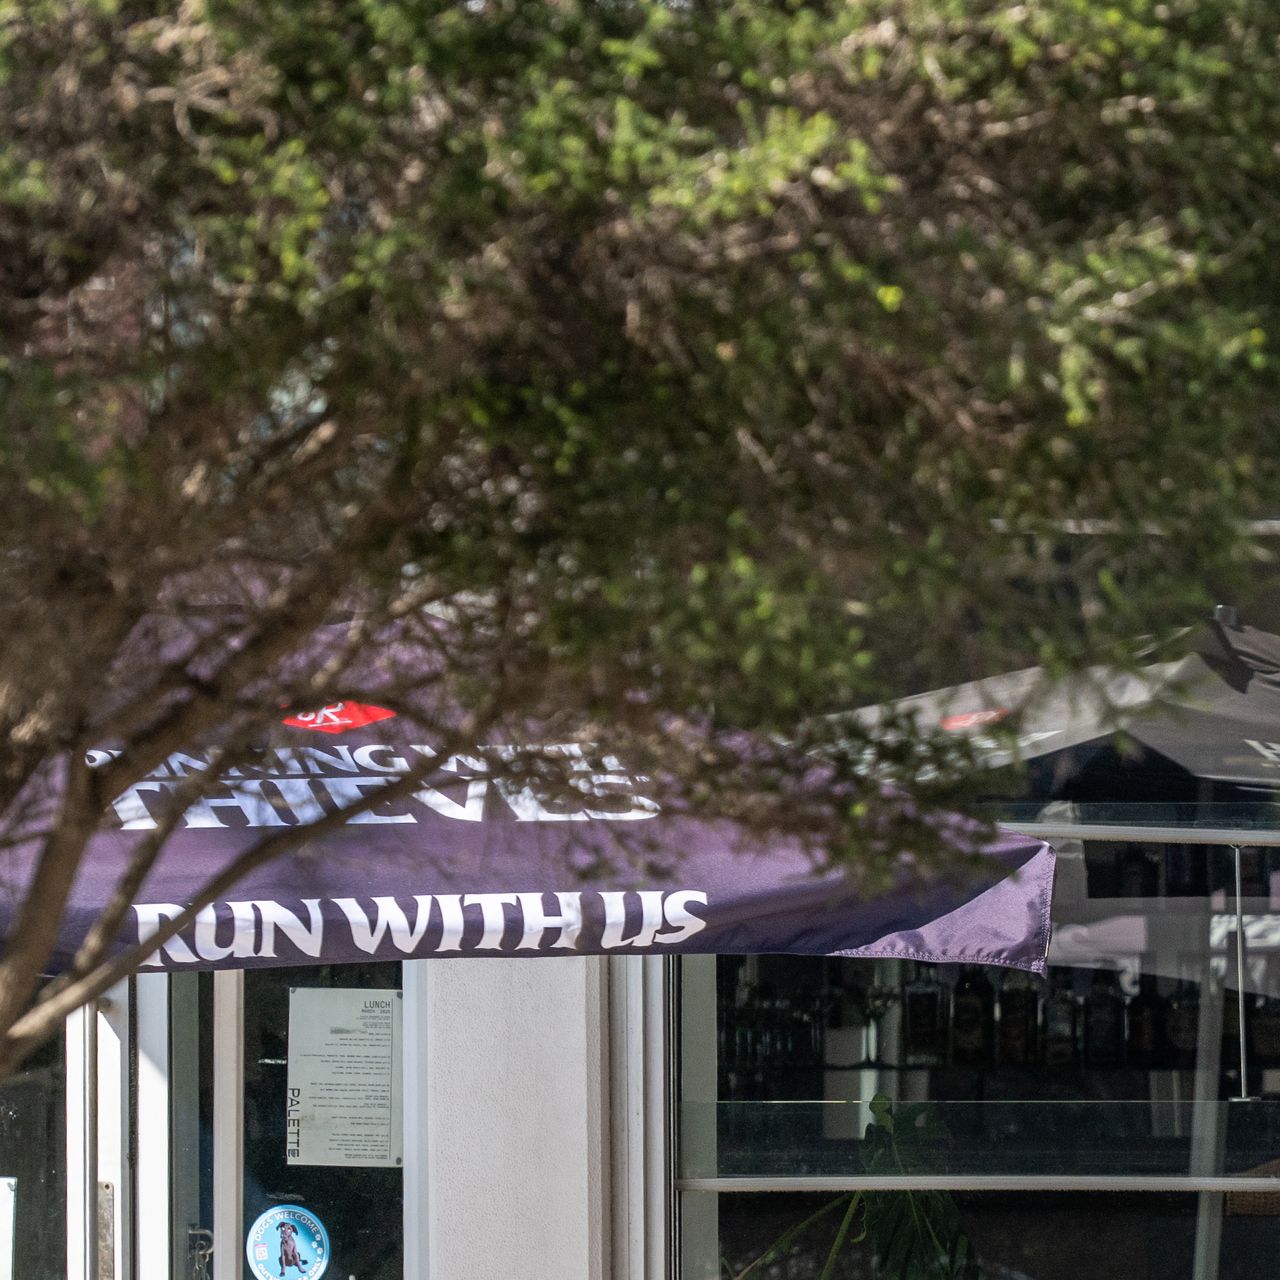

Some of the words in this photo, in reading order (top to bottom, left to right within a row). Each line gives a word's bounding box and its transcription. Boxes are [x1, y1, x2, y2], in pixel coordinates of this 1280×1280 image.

[131, 898, 323, 967] RUN
[330, 891, 583, 955] WITH
[599, 889, 709, 948] US
[364, 1000, 391, 1009] LUNCH
[287, 1087, 300, 1158] PALETTE
[254, 1215, 274, 1241] DOGS
[274, 1211, 318, 1234] WELCOME
[308, 1257, 322, 1275] ONLY
